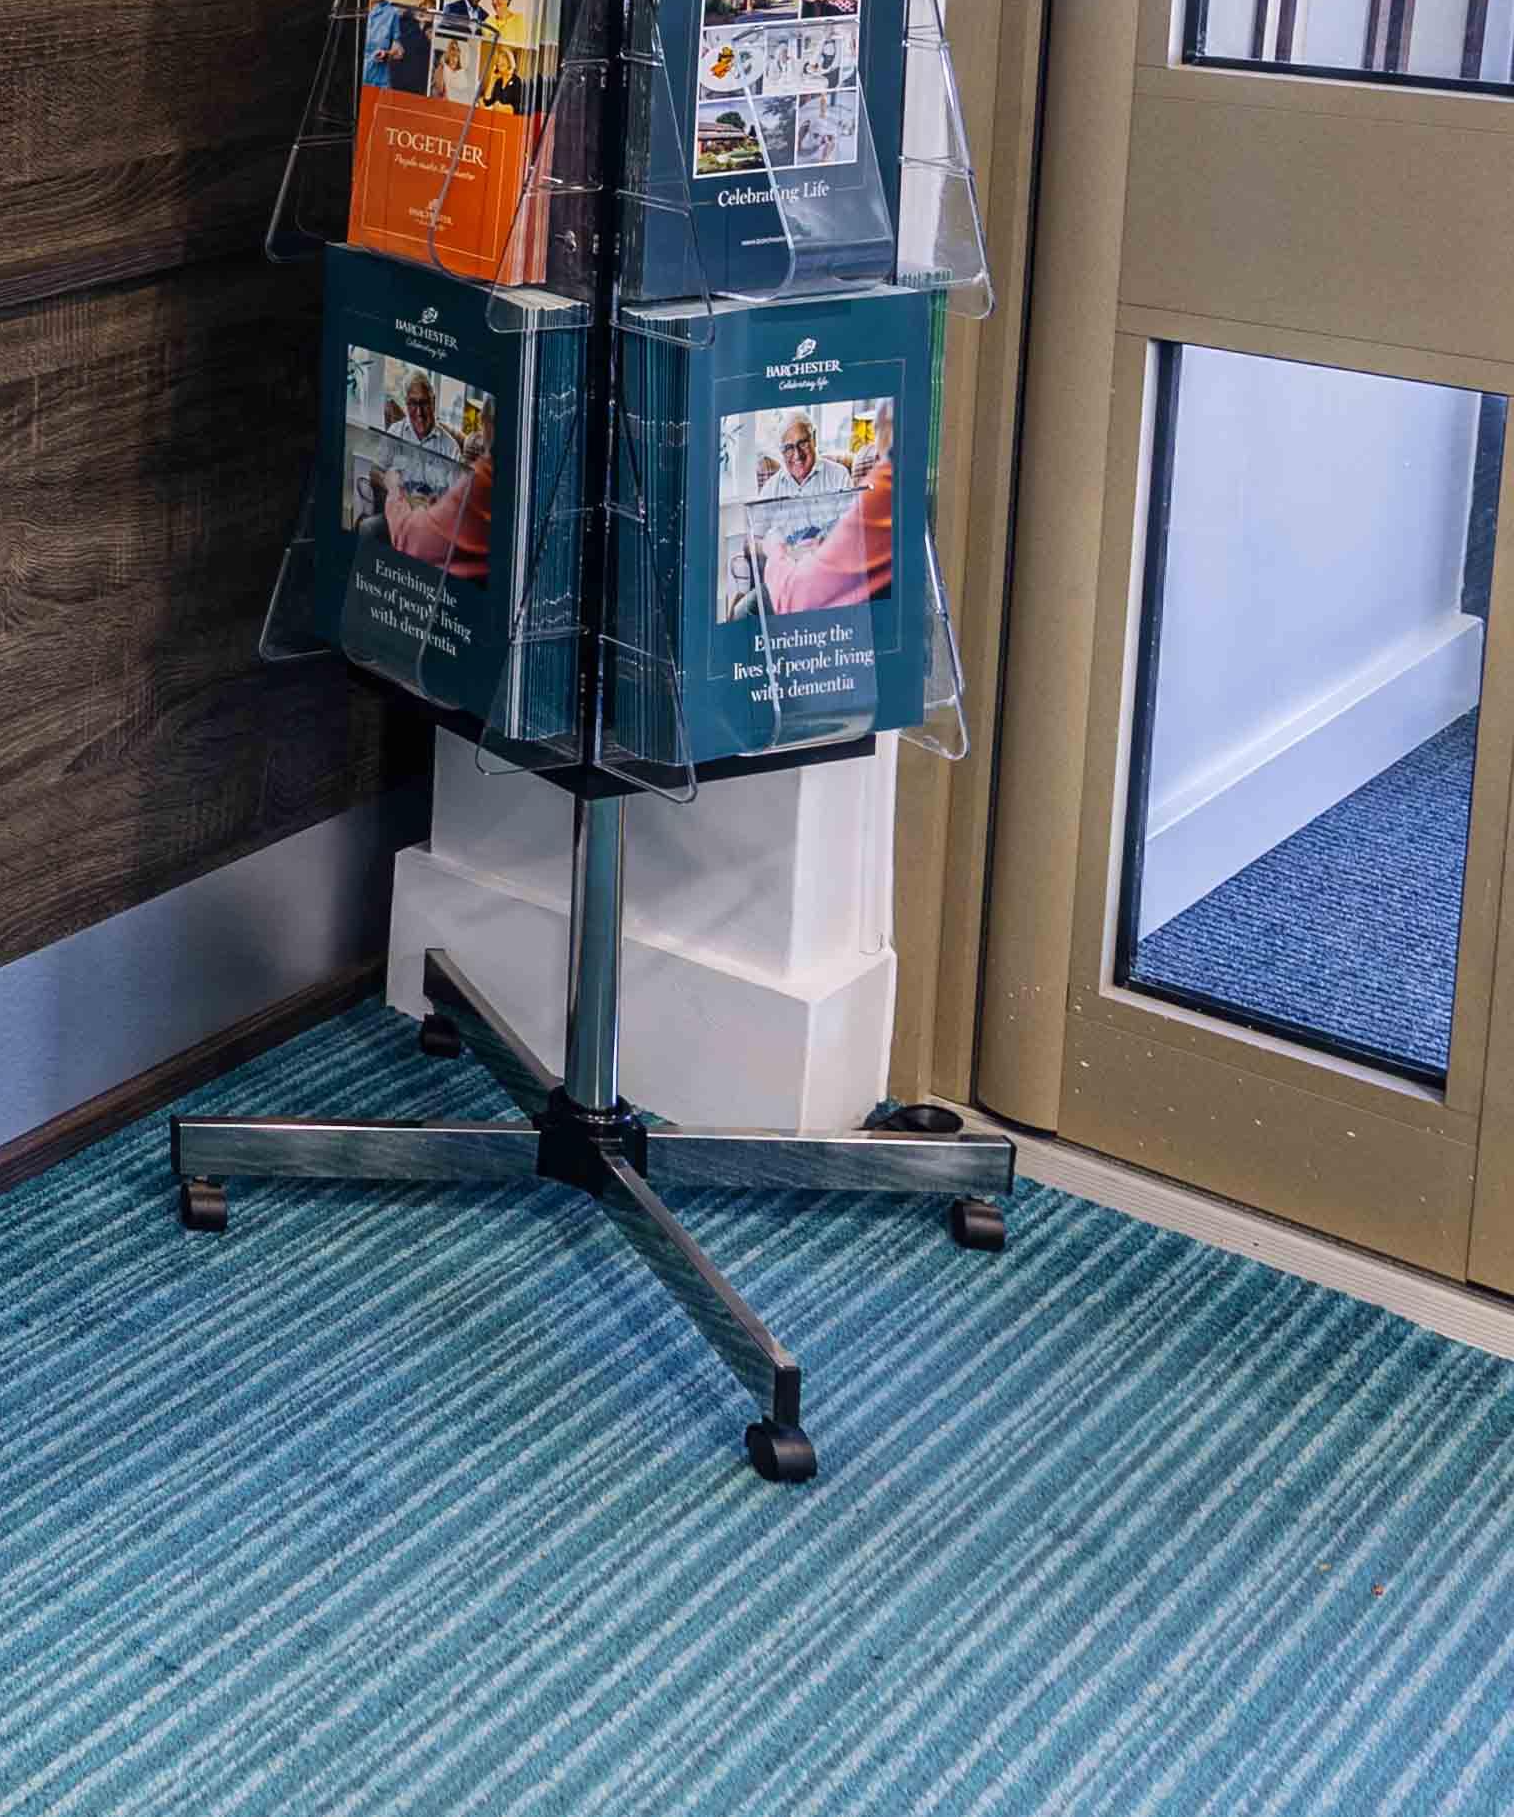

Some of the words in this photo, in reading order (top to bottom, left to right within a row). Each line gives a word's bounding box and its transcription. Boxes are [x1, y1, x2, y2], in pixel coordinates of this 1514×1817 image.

[386, 127, 489, 169] TOGETHER
[718, 184, 800, 207] Celebratng
[803, 180, 830, 198] Life
[395, 318, 459, 351] BARCHESTER
[766, 359, 843, 378] BARCHESTER
[375, 558, 436, 601] Enriching
[439, 585, 458, 607] he
[355, 571, 382, 597] lives
[383, 588, 398, 604] of
[441, 608, 471, 644] living
[371, 606, 397, 629] with
[754, 628, 828, 652] Enriching
[830, 623, 854, 642] the
[733, 661, 763, 681] lives
[766, 656, 784, 675] of
[786, 651, 832, 678] people
[835, 647, 875, 668] living
[750, 681, 784, 702] with
[788, 673, 855, 698] dementia
